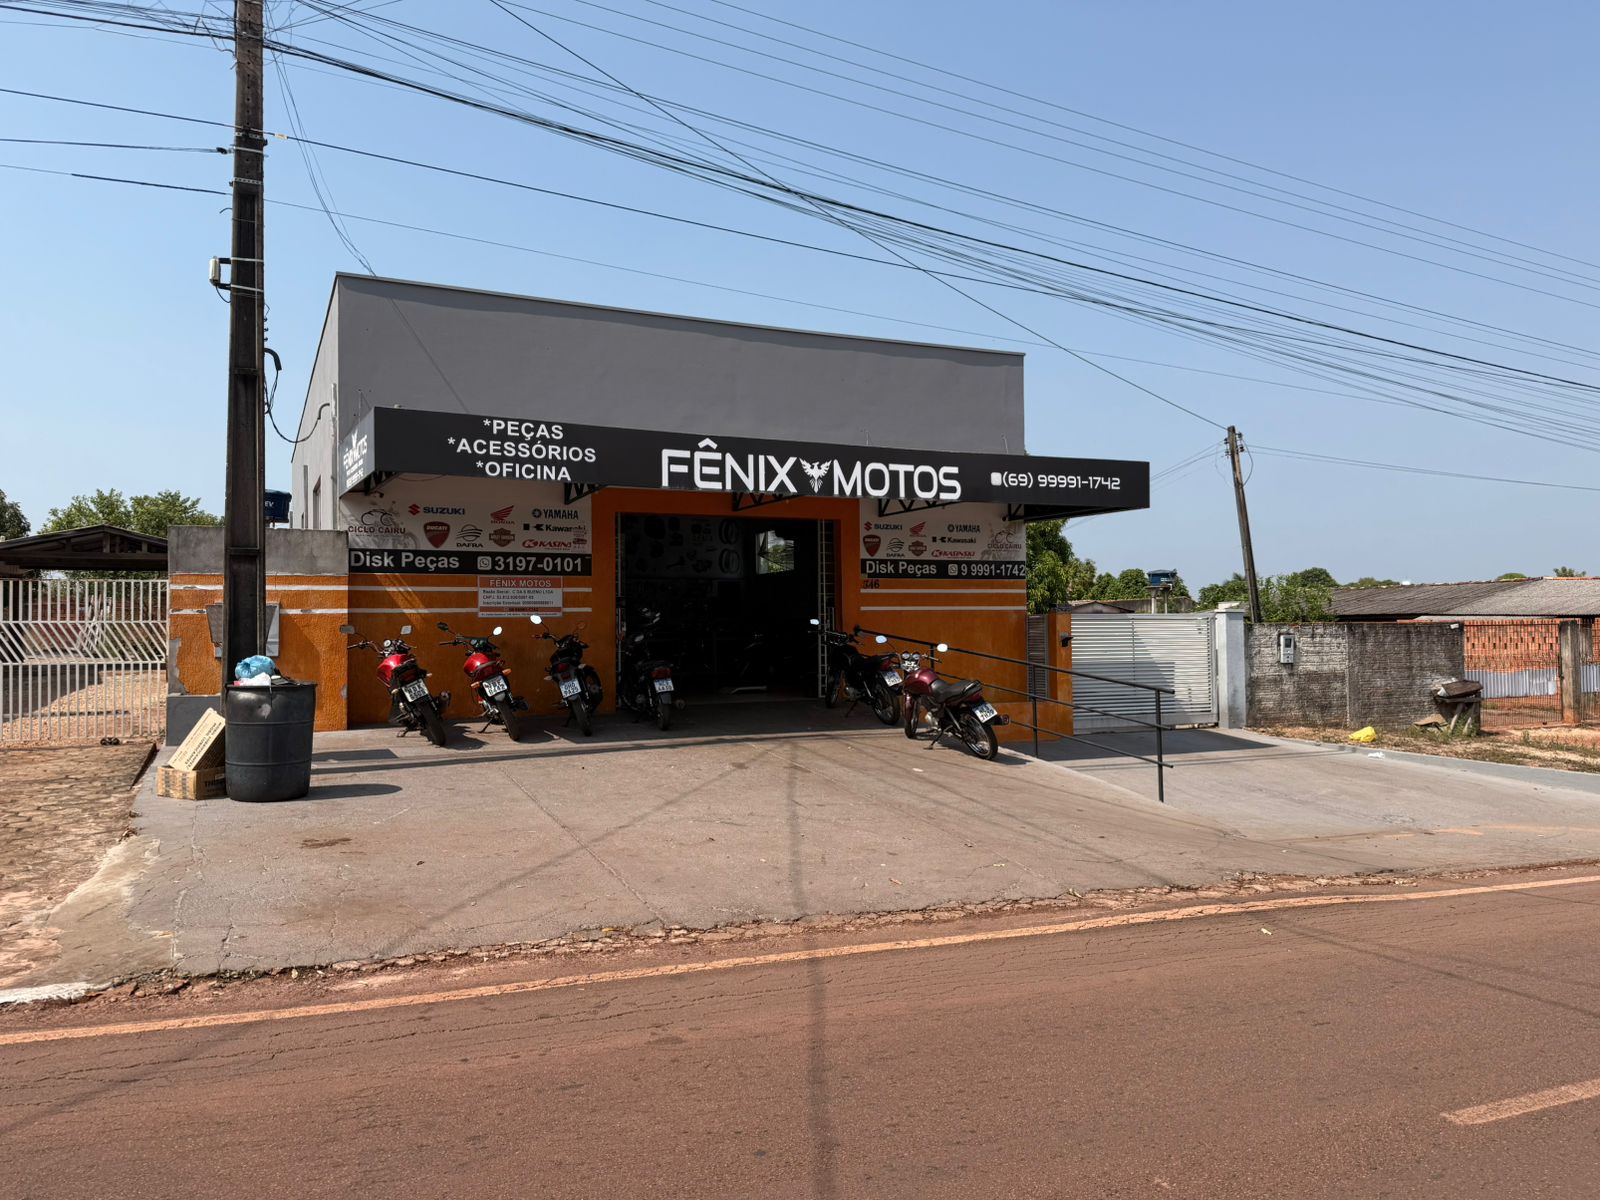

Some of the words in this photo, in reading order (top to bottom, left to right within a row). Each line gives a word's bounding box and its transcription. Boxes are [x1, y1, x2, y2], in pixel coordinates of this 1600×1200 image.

[661, 438, 798, 493] FÊNIX
[833, 459, 962, 500] MOTOS
[1002, 471, 1034, 488] (69)
[1038, 474, 1120, 490] 99991-1742
[423, 506, 465, 514] SUZUKI
[543, 509, 578, 520] YAMAHA
[378, 526, 406, 534] CAIRU
[956, 524, 980, 532] YAMAHA
[350, 550, 394, 567] Disk
[401, 552, 460, 572] Peças
[494, 556, 582, 572] 3197-0101
[866, 561, 895, 574] Disk
[899, 562, 937, 576] Peças
[961, 564, 968, 575] 9
[970, 564, 1026, 576] 9991-1742
